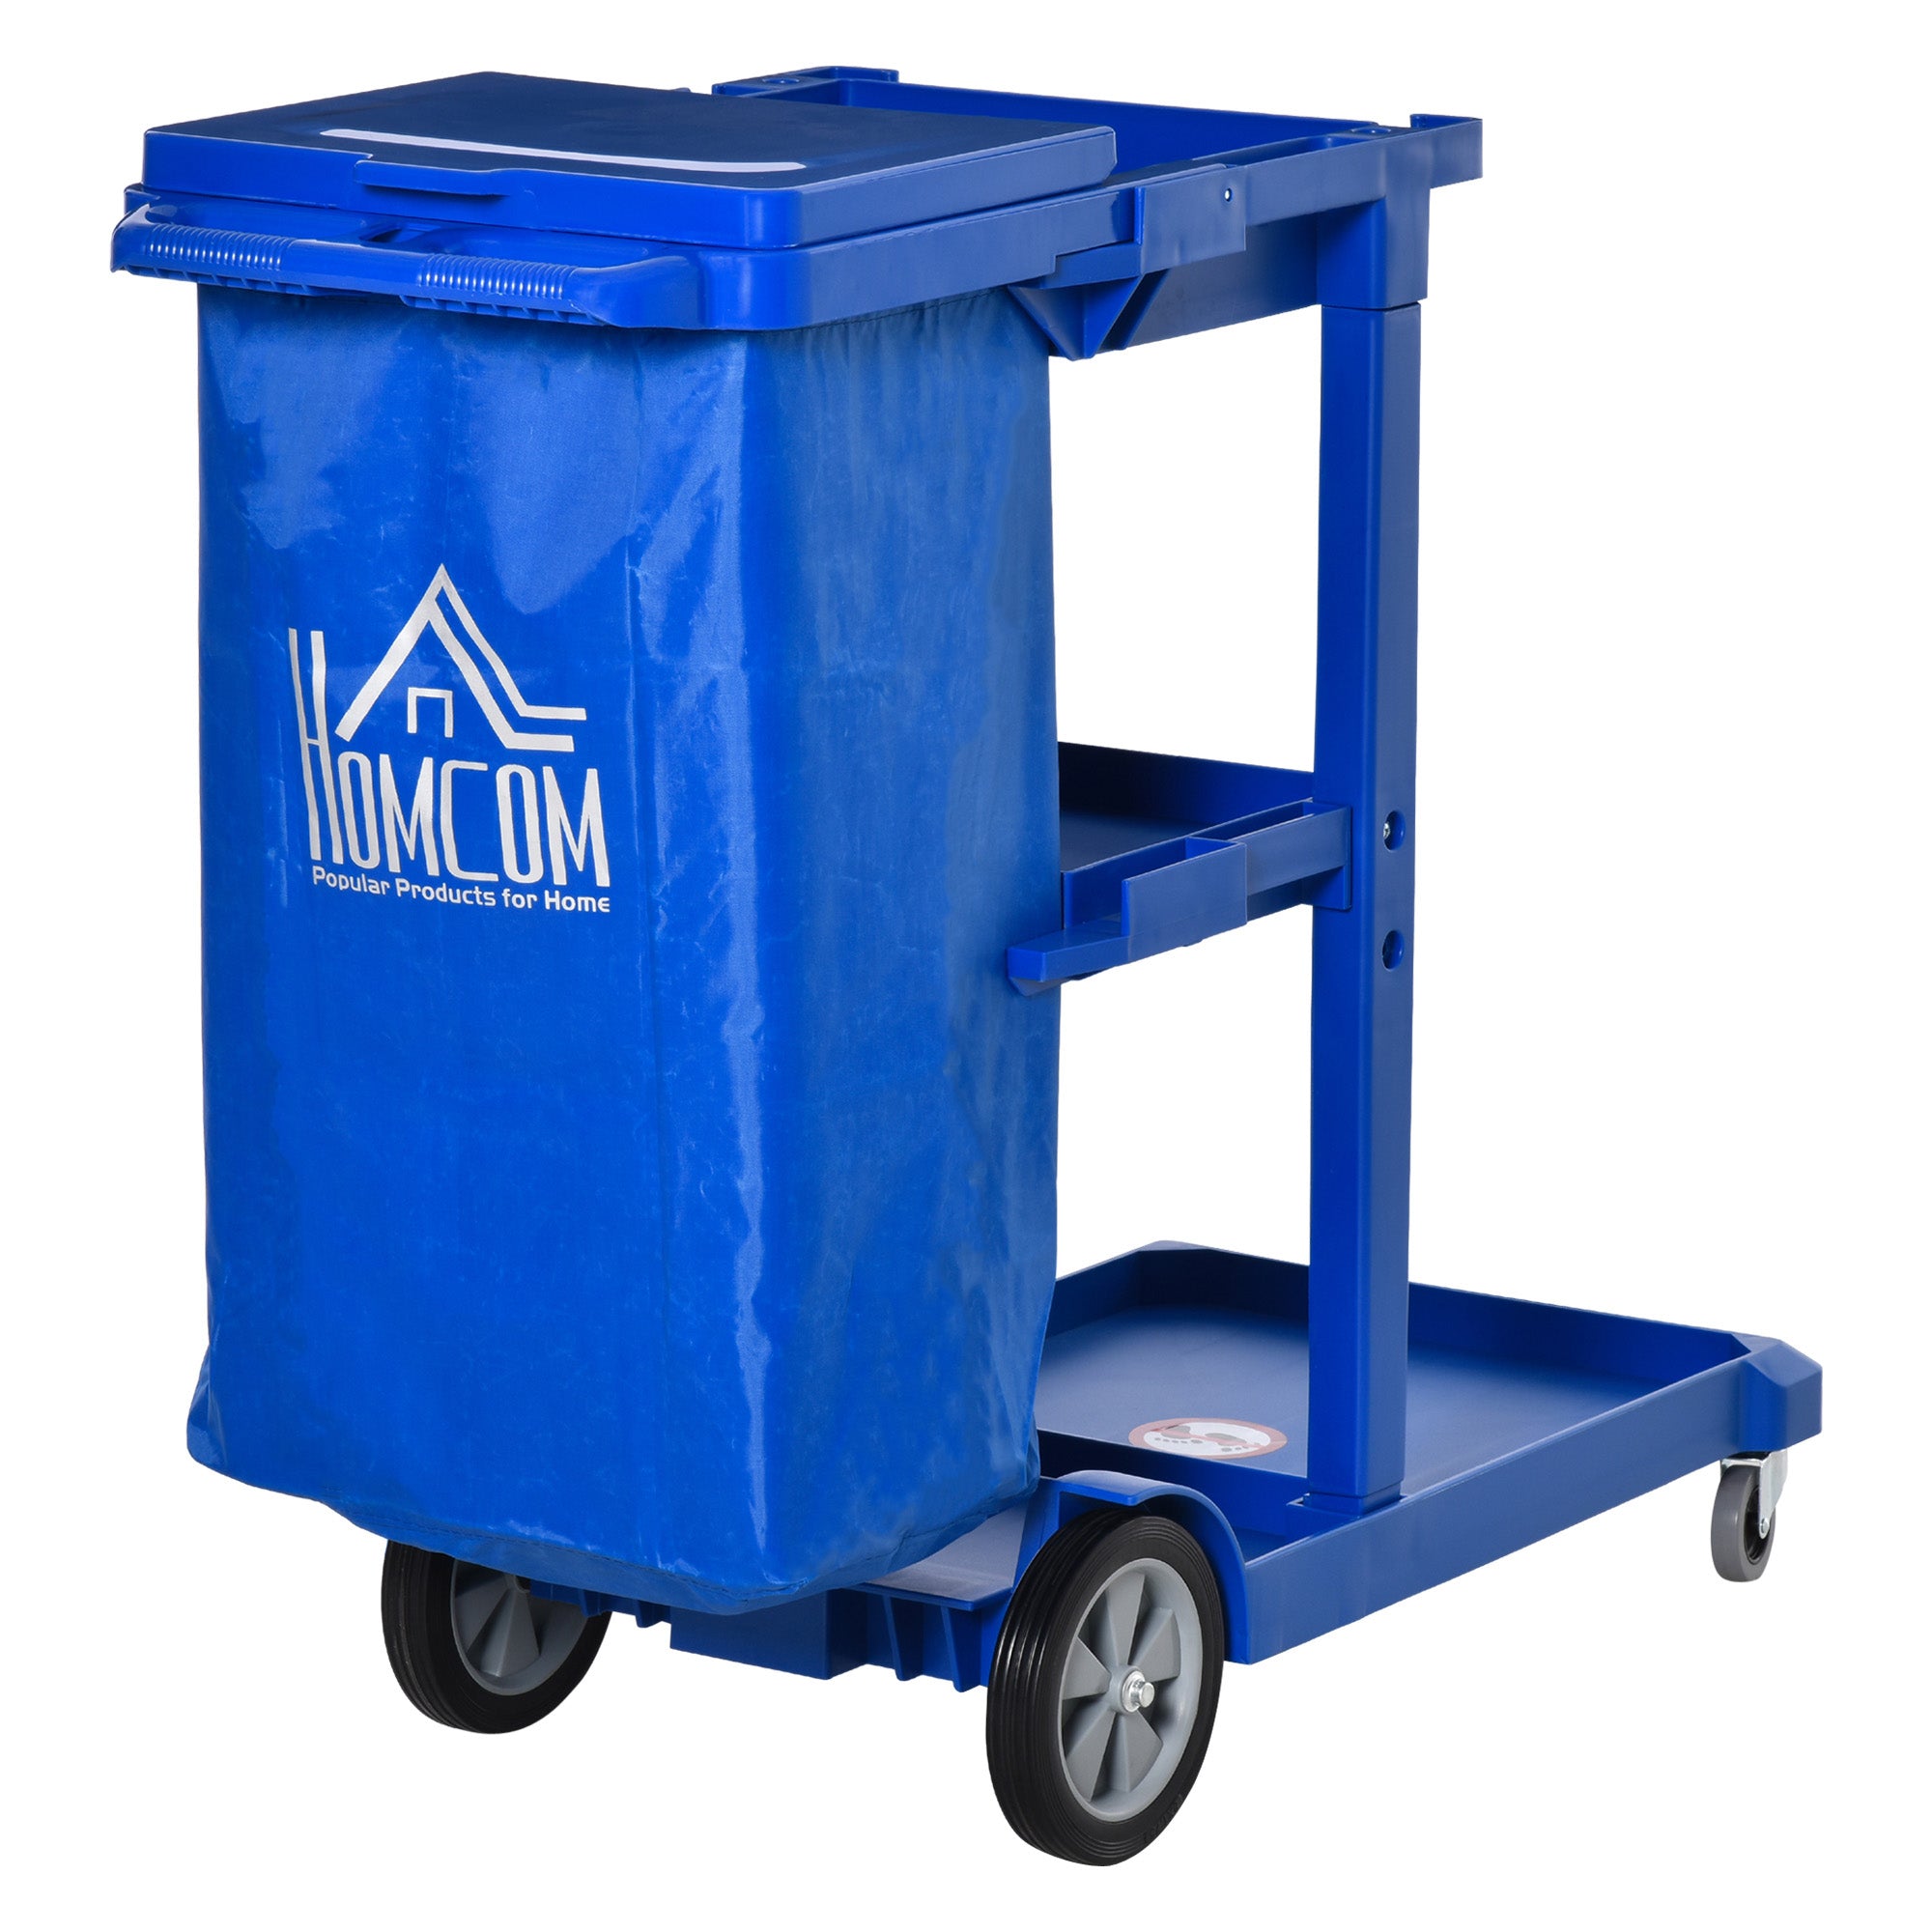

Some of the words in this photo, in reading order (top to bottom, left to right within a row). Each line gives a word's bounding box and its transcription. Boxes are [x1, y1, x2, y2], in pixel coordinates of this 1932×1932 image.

[288, 628, 611, 888] HOMCOM
[312, 865, 390, 895] Popular
[395, 877, 497, 908] Products
[501, 888, 538, 909] for
[544, 890, 611, 913] Home
